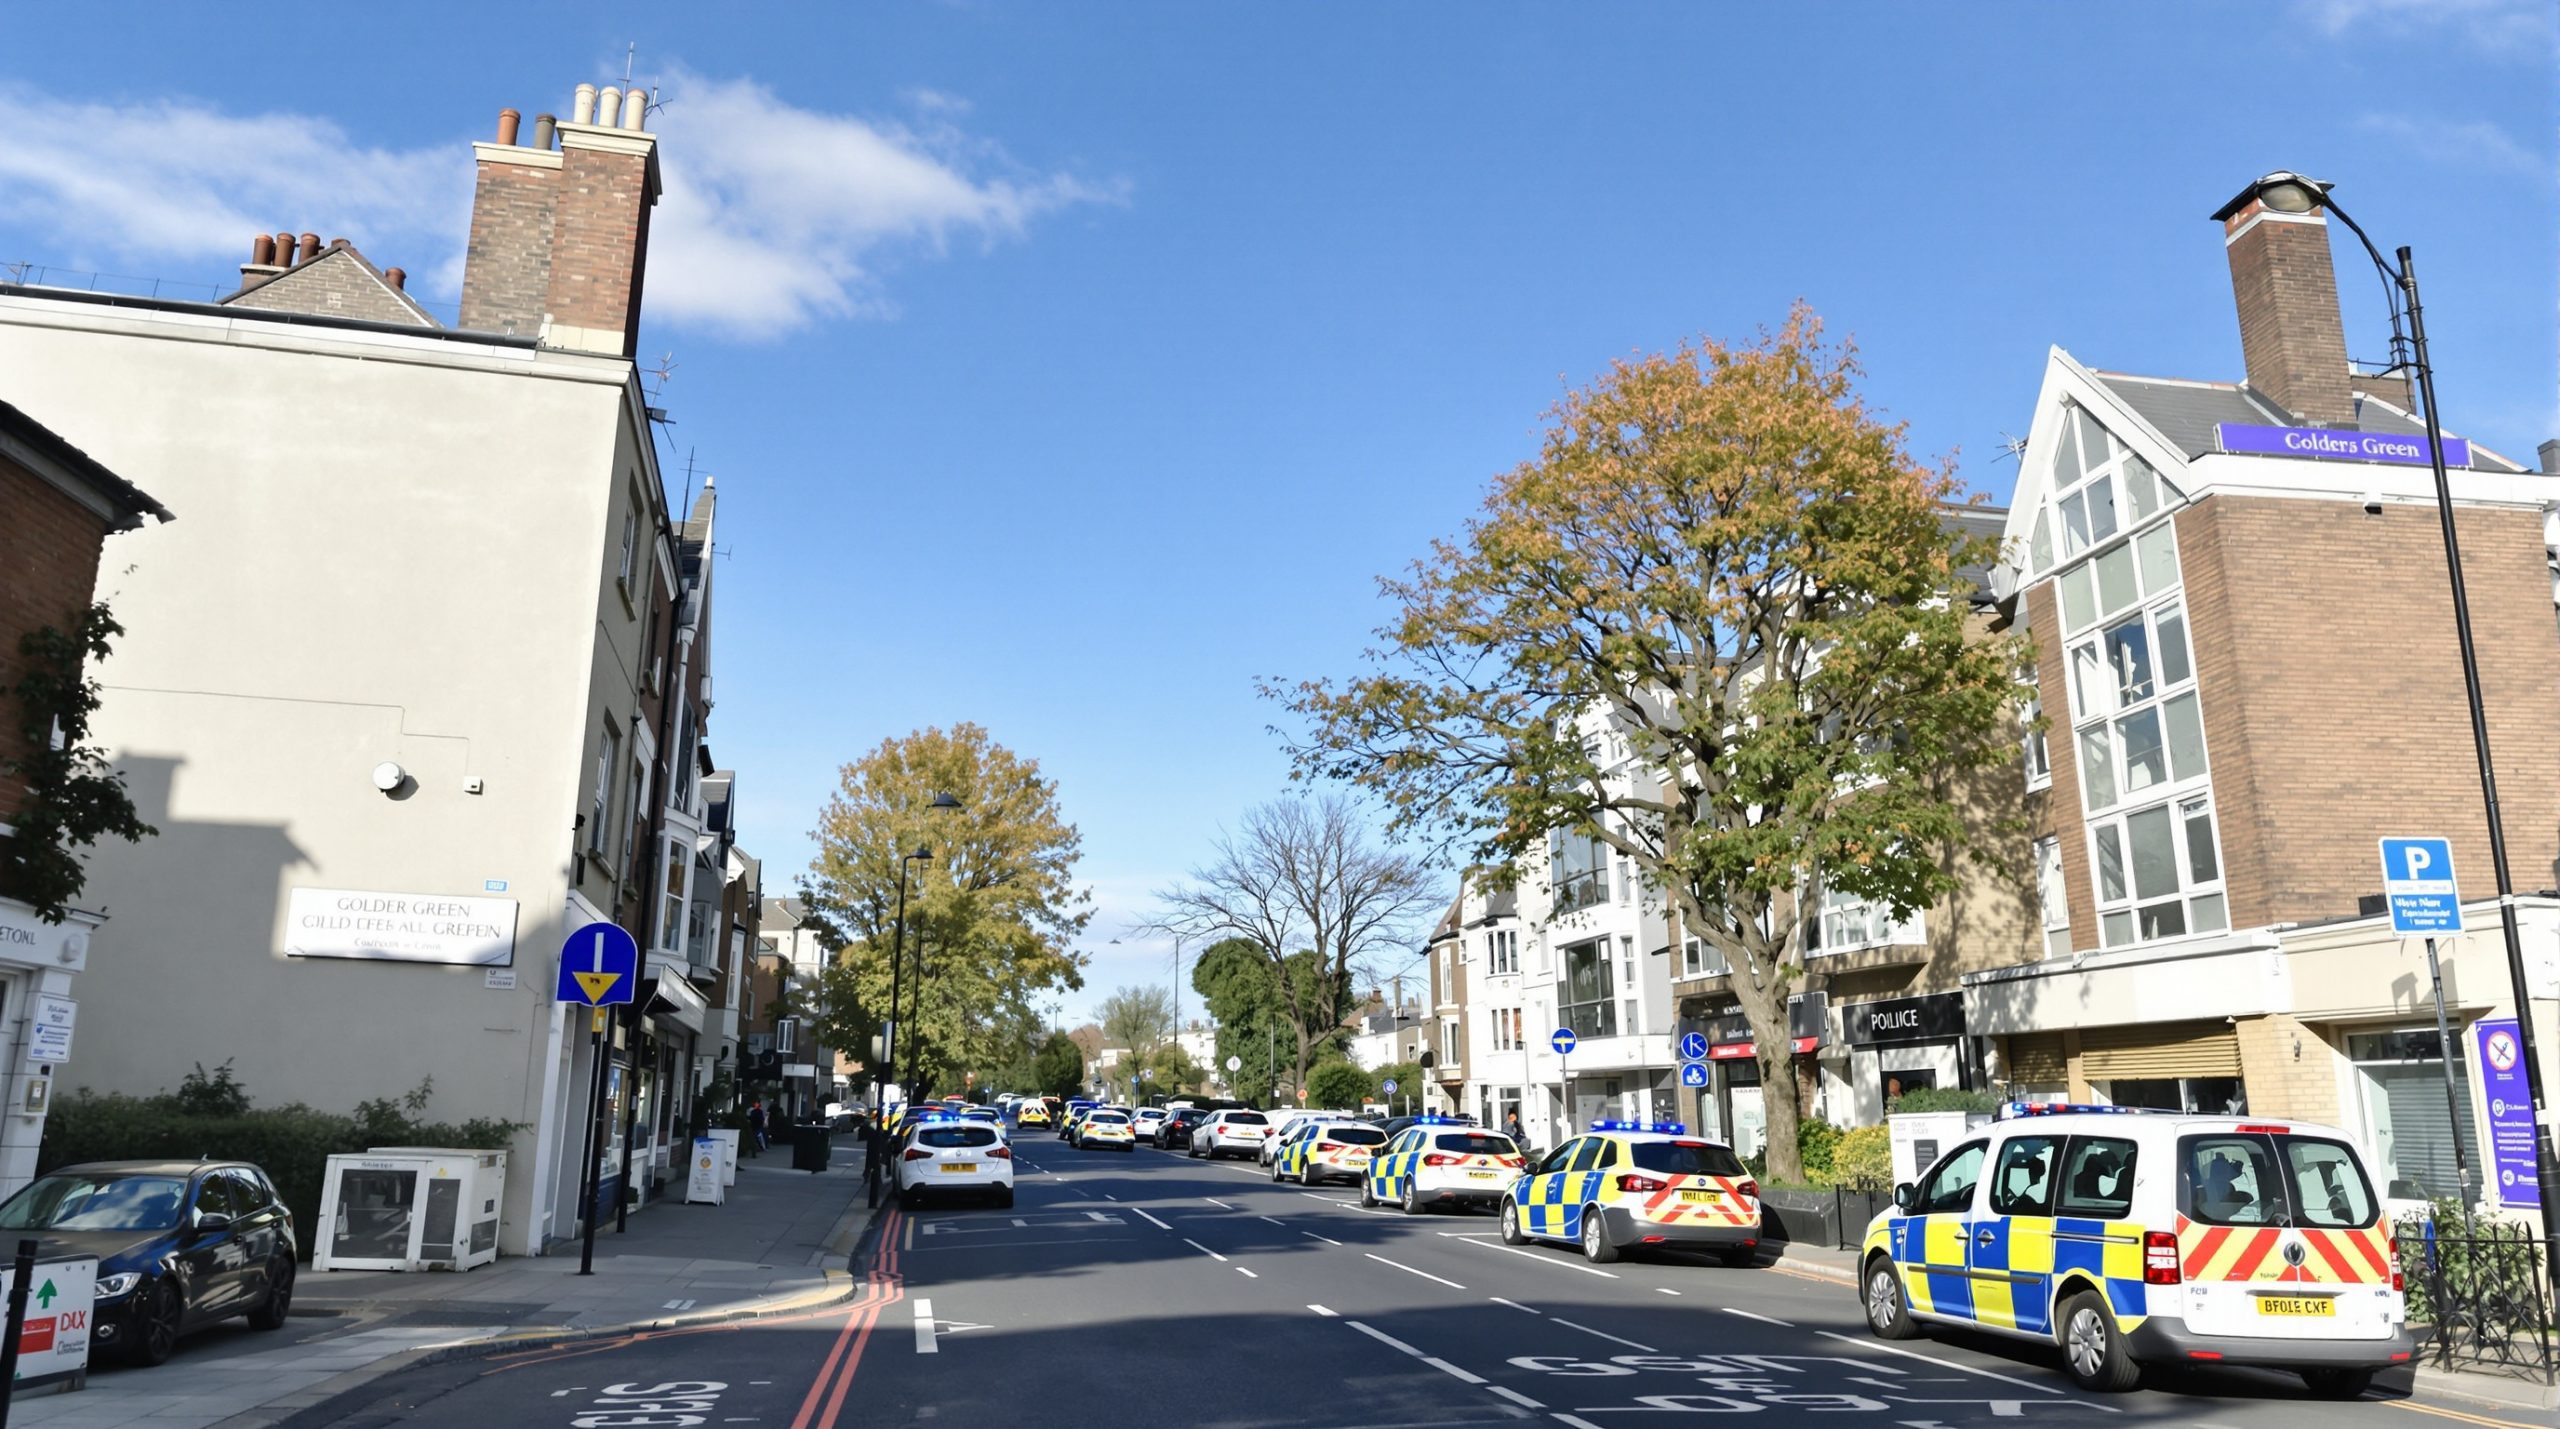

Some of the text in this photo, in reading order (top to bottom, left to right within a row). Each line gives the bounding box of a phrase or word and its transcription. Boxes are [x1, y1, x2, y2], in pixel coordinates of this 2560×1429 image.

[2362, 437, 2420, 458] Green
[2405, 846, 2431, 880] P
[337, 896, 471, 918] GOLDER GREEN
